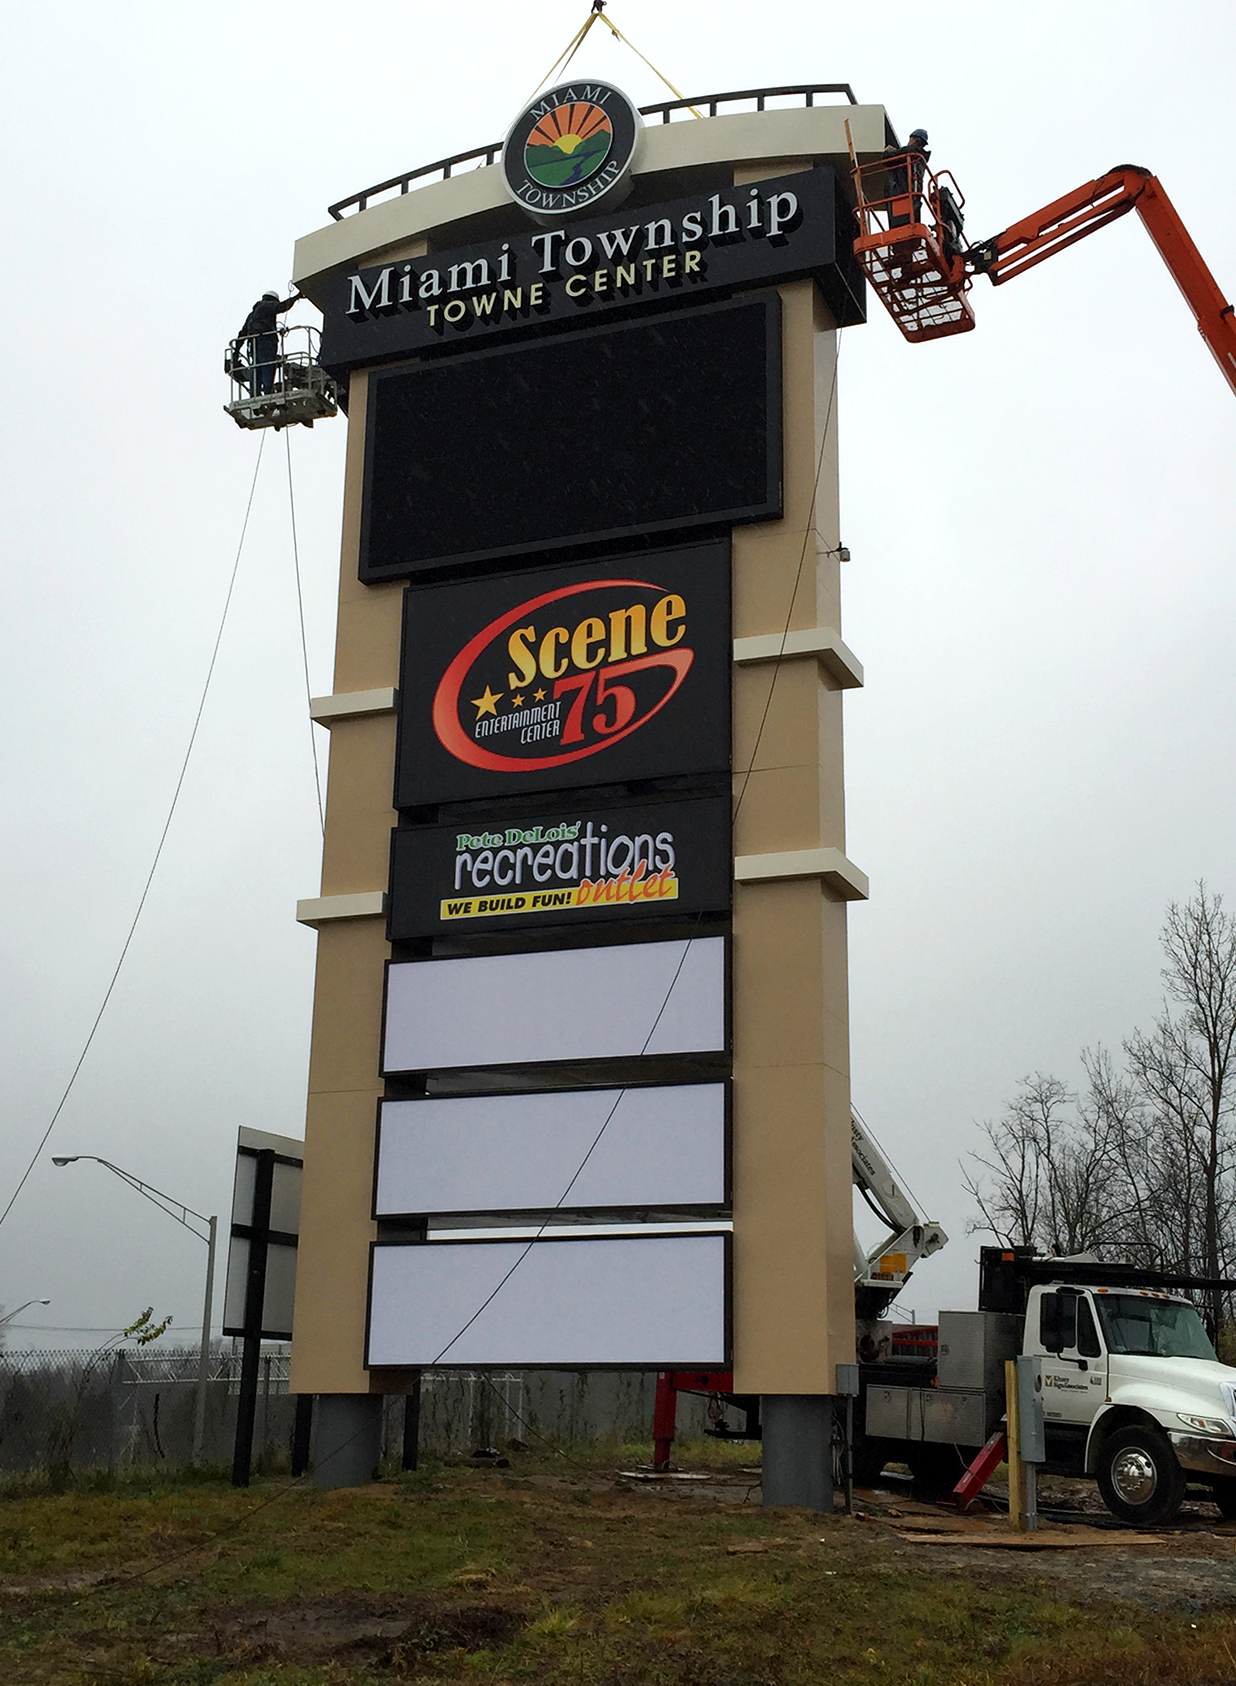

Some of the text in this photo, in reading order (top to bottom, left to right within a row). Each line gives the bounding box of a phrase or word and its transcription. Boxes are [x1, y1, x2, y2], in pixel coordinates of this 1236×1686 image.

[530, 85, 612, 121] MIAMI
[516, 160, 620, 208] TOWNSHIP
[345, 187, 799, 315] Miami Township
[426, 250, 702, 327] TOWNE CENTER
[507, 593, 688, 691] Scene
[474, 701, 563, 739] ENTERTAINMENT
[552, 667, 637, 746] 75
[520, 719, 561, 746] CENTER
[454, 821, 676, 890] recreations
[455, 820, 582, 852] Pete DeLois'
[447, 891, 572, 916] WE BUILD FUN!
[576, 859, 677, 907] outlet
